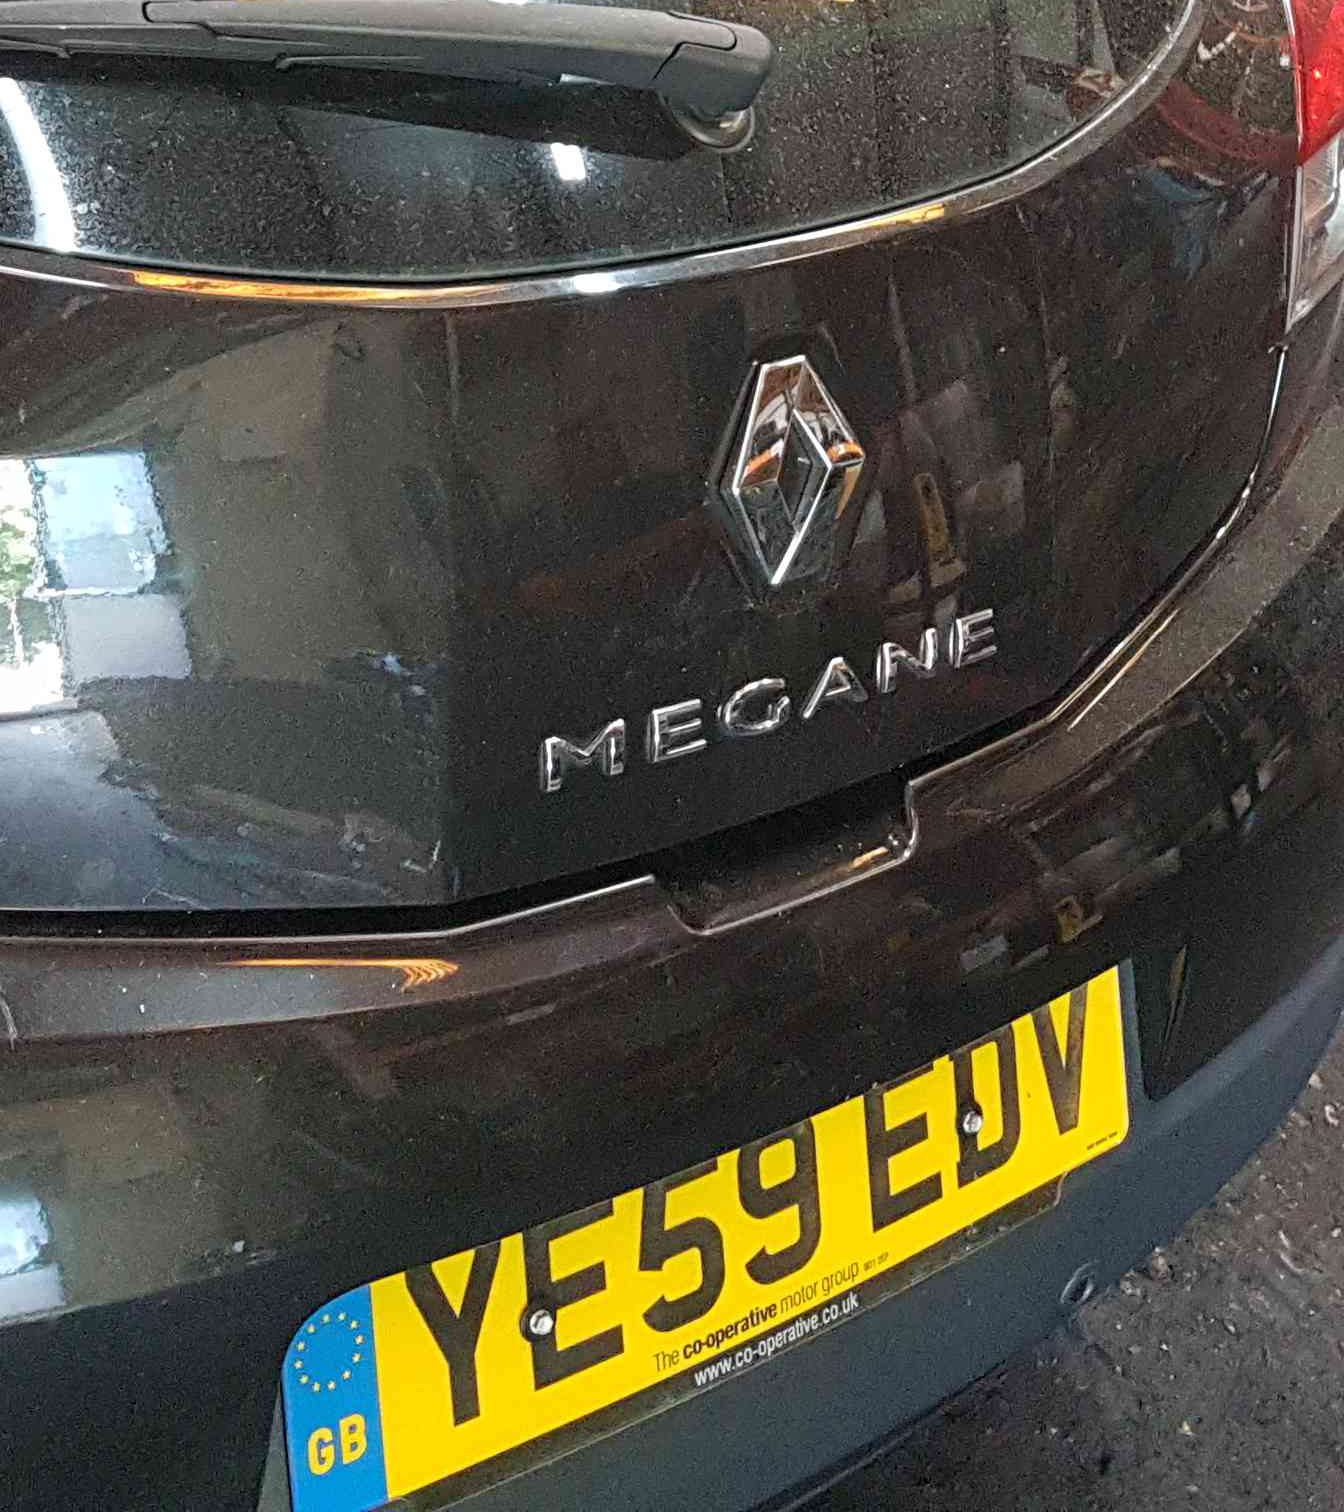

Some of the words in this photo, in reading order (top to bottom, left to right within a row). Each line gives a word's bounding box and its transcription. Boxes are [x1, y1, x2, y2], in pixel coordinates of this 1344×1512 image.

[540, 608, 998, 793] MEGANE
[404, 1117, 823, 1427] YE59
[653, 1350, 681, 1373] The
[682, 1303, 778, 1360] co-operative
[780, 1281, 819, 1314] motor
[821, 1261, 860, 1297] group
[693, 1291, 860, 1387] www.co-operative.co.uk
[307, 1413, 368, 1476] GB
